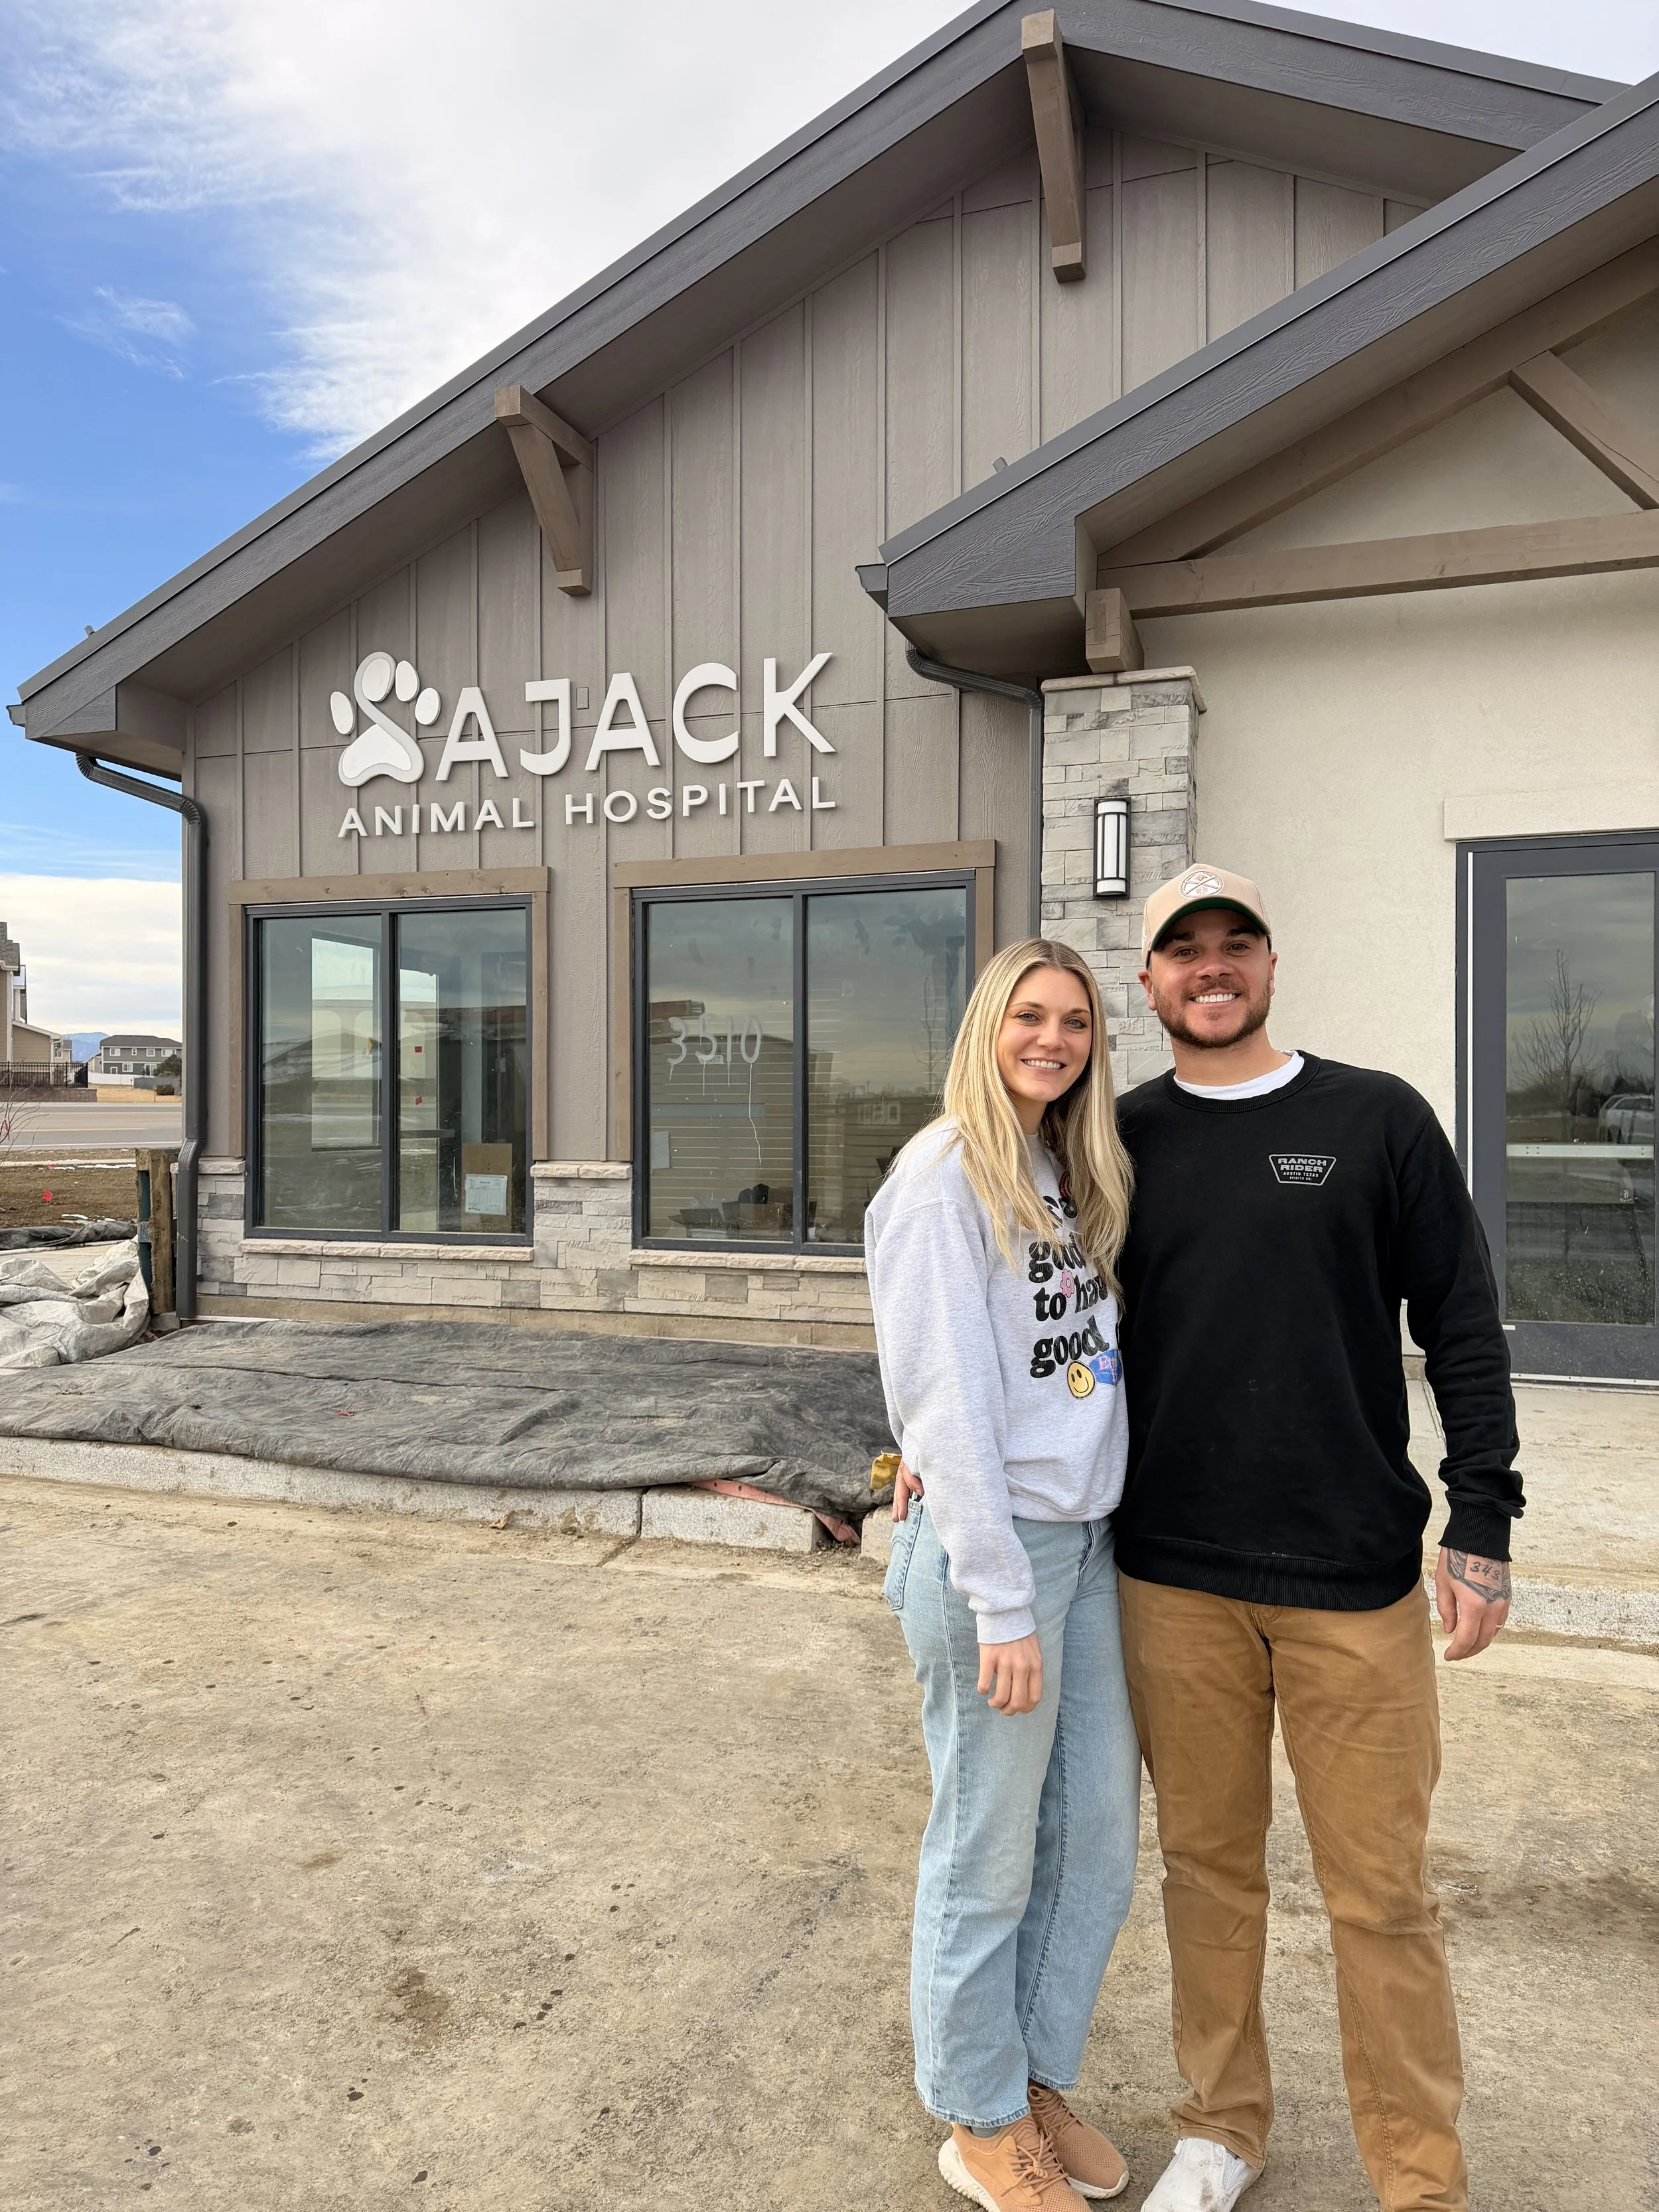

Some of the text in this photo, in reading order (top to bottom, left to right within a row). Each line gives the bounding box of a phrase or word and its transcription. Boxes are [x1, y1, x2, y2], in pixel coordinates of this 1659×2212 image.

[338, 776, 837, 839] ANIMAL HOSPITAL
[667, 1014, 762, 1065] 3510
[1033, 1274, 1108, 1321] to hav
[1030, 1315, 1110, 1378] good
